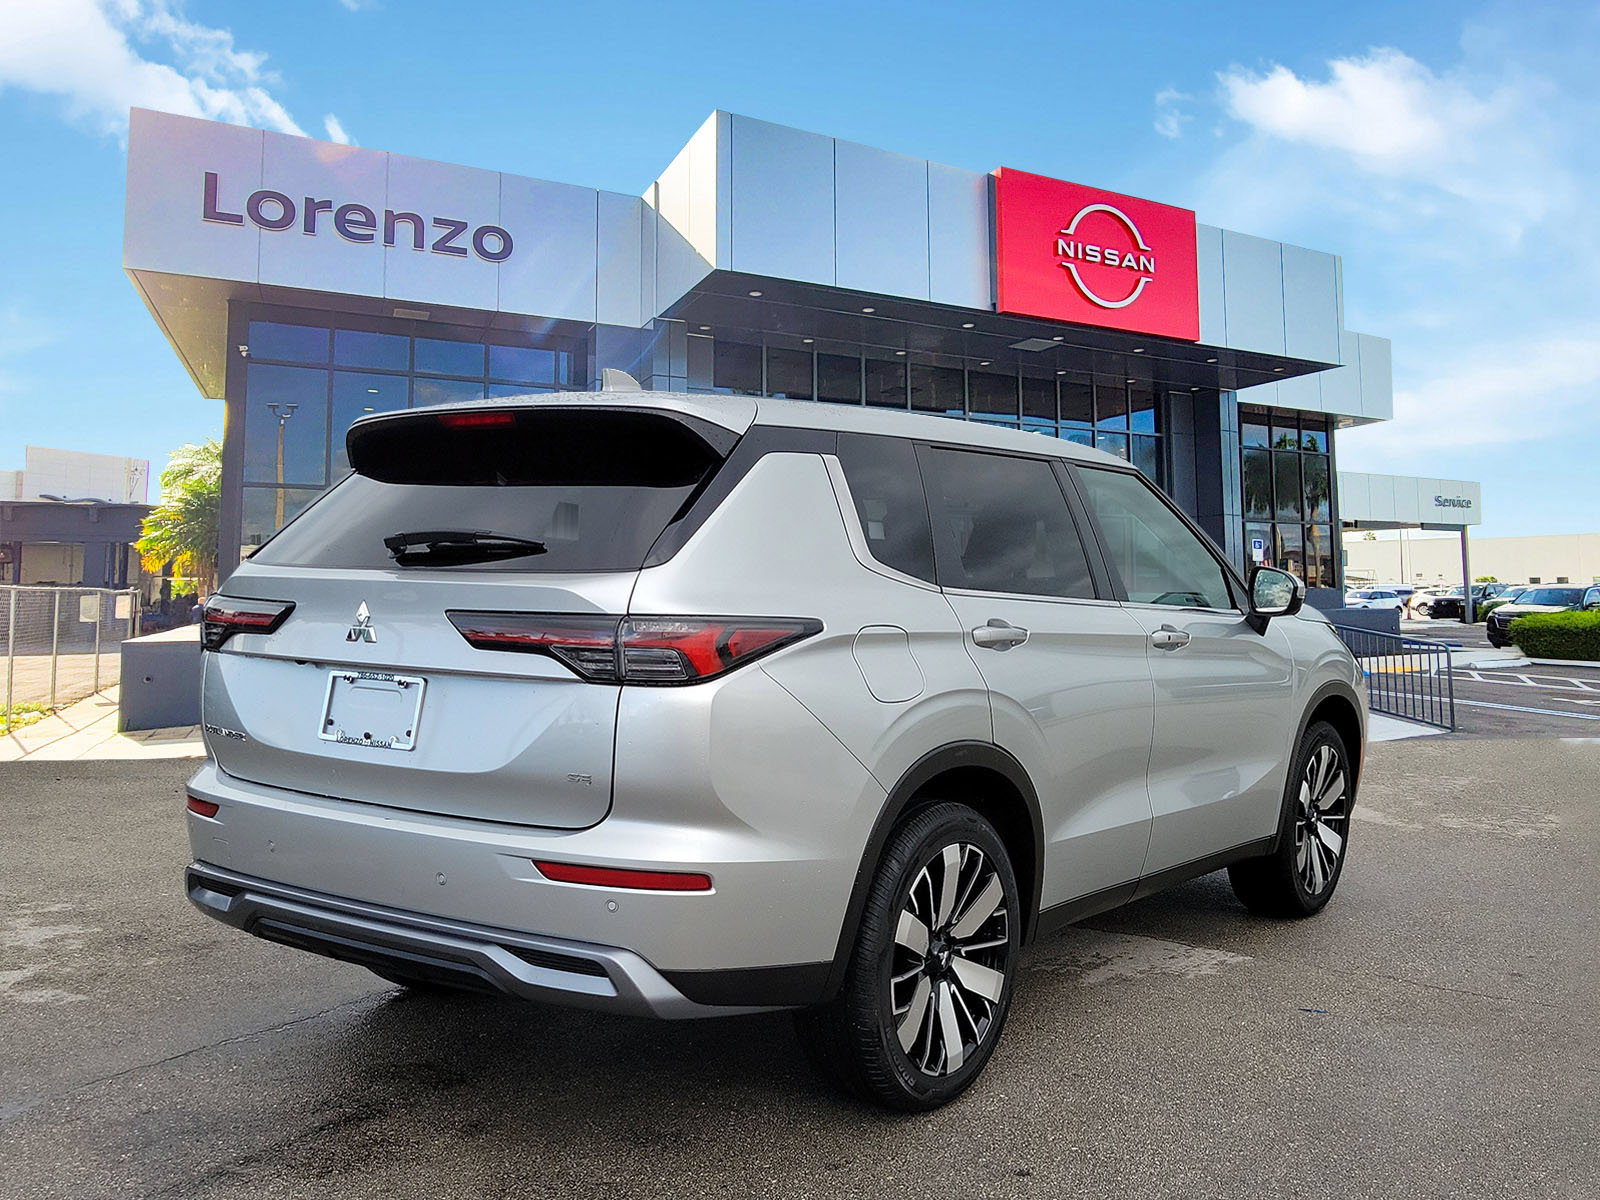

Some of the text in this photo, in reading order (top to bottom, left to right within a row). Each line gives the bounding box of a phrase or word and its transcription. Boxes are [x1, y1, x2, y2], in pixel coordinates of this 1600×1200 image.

[202, 171, 514, 262] Lorenzo
[1057, 238, 1155, 273] NISSAN
[1434, 495, 1472, 508] Service
